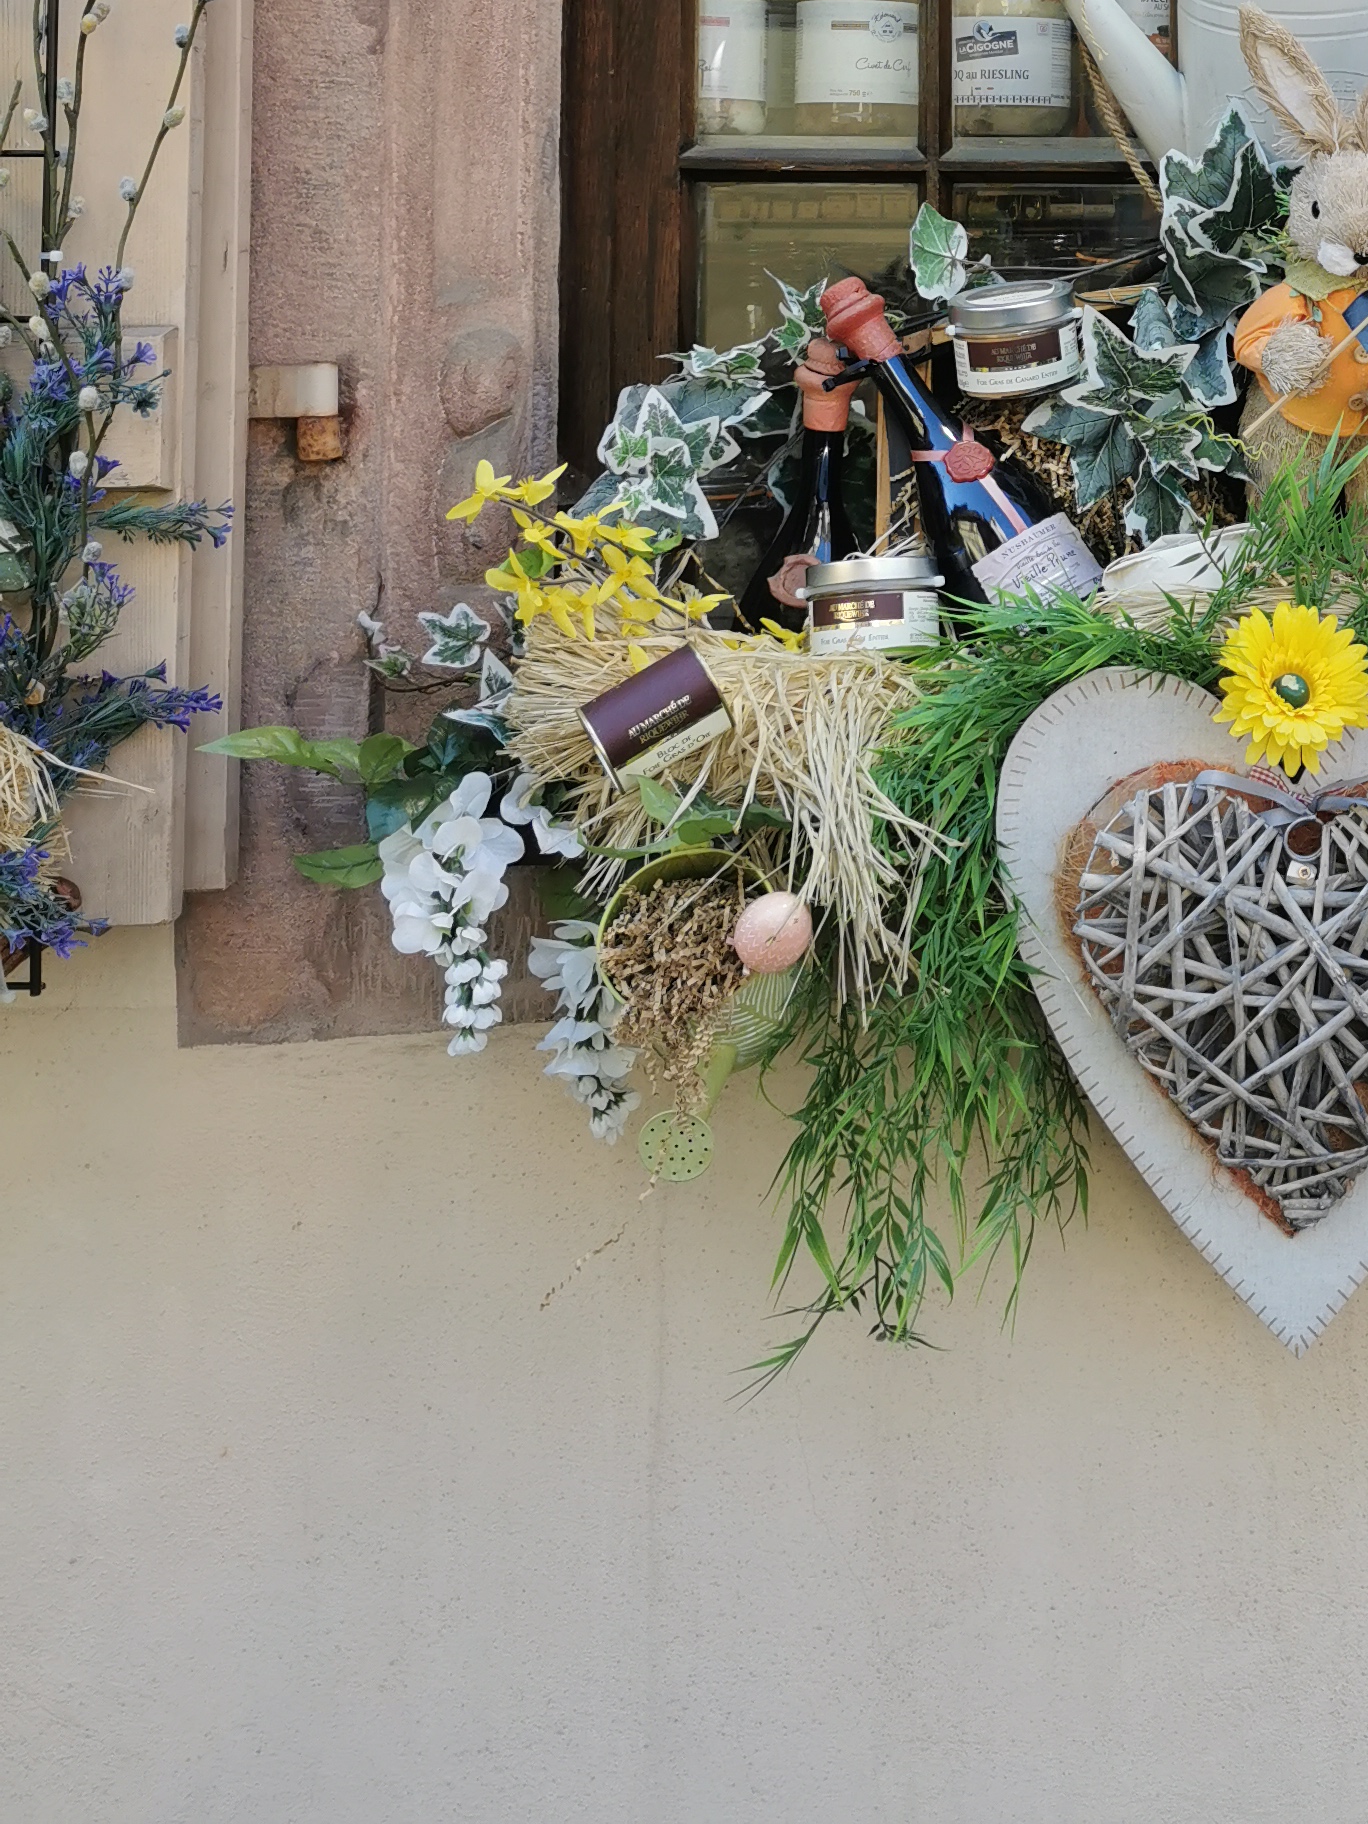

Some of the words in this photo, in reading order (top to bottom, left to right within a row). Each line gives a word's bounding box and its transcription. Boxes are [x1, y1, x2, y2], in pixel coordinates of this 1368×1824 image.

[966, 39, 1014, 53] CIGOGNE
[883, 59, 892, 70] de
[966, 71, 977, 80] au
[980, 69, 1029, 80] RIESLING
[1015, 374, 1040, 384] CANARD
[1001, 523, 1057, 559] NUSBAUMER
[656, 741, 679, 759] BLOC
[642, 761, 660, 775] FOIE
[662, 748, 687, 763] GRAS
